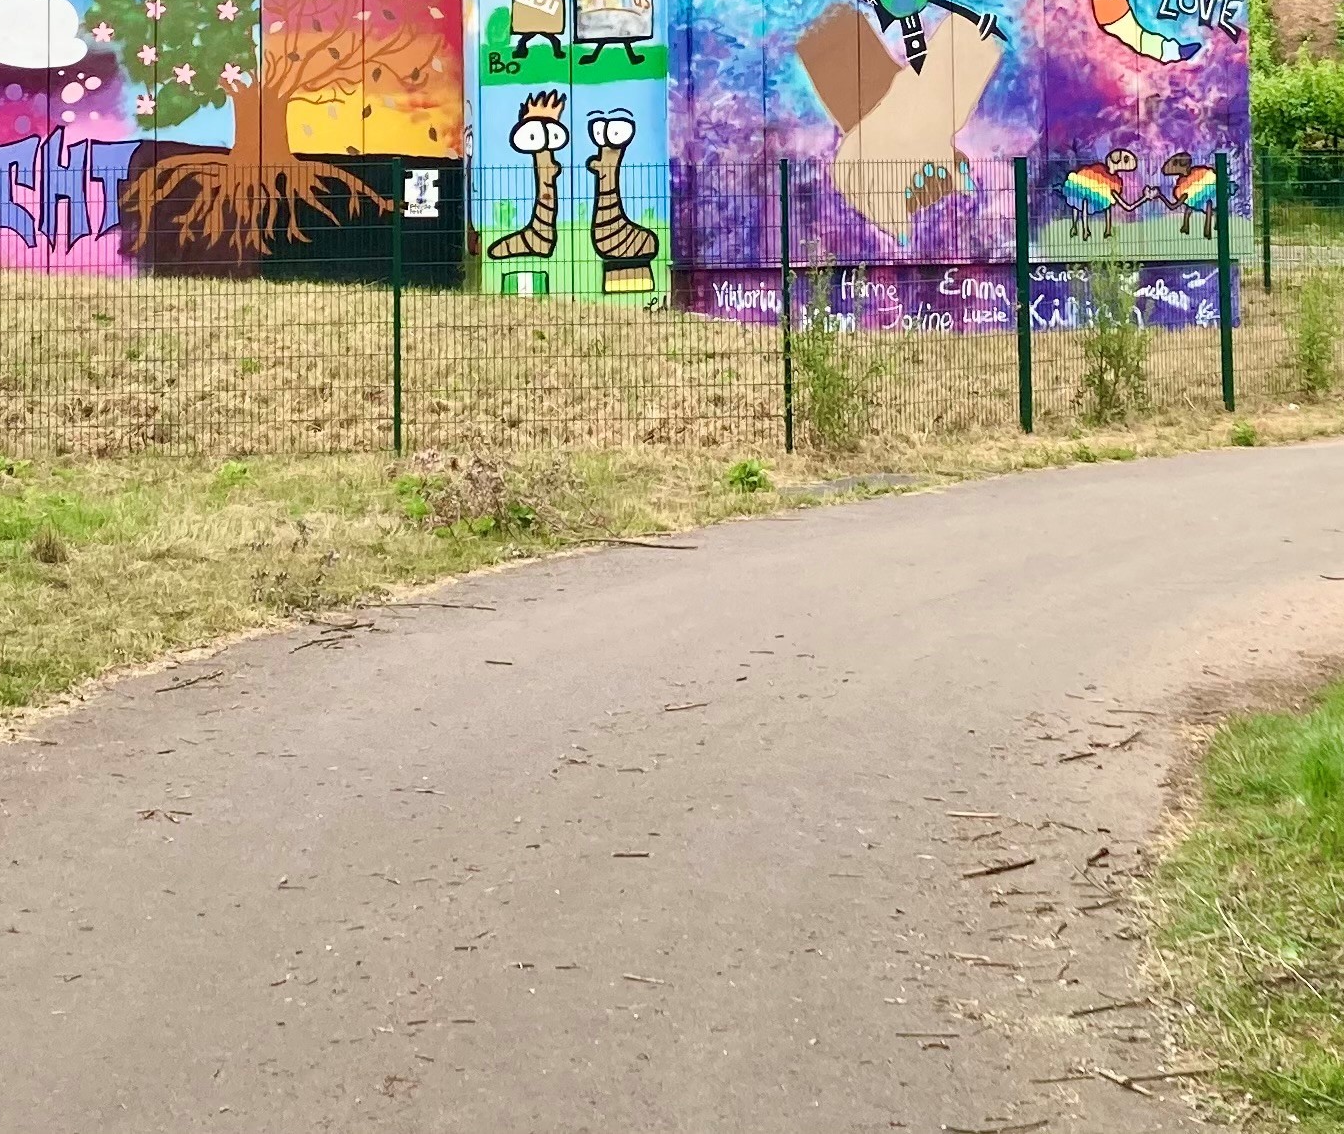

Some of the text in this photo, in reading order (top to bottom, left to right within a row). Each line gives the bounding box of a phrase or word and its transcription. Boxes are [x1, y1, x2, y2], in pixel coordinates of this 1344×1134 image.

[939, 267, 1011, 306] Emma
[963, 306, 1009, 324] Luzie
[1028, 293, 1145, 330] Kilin
